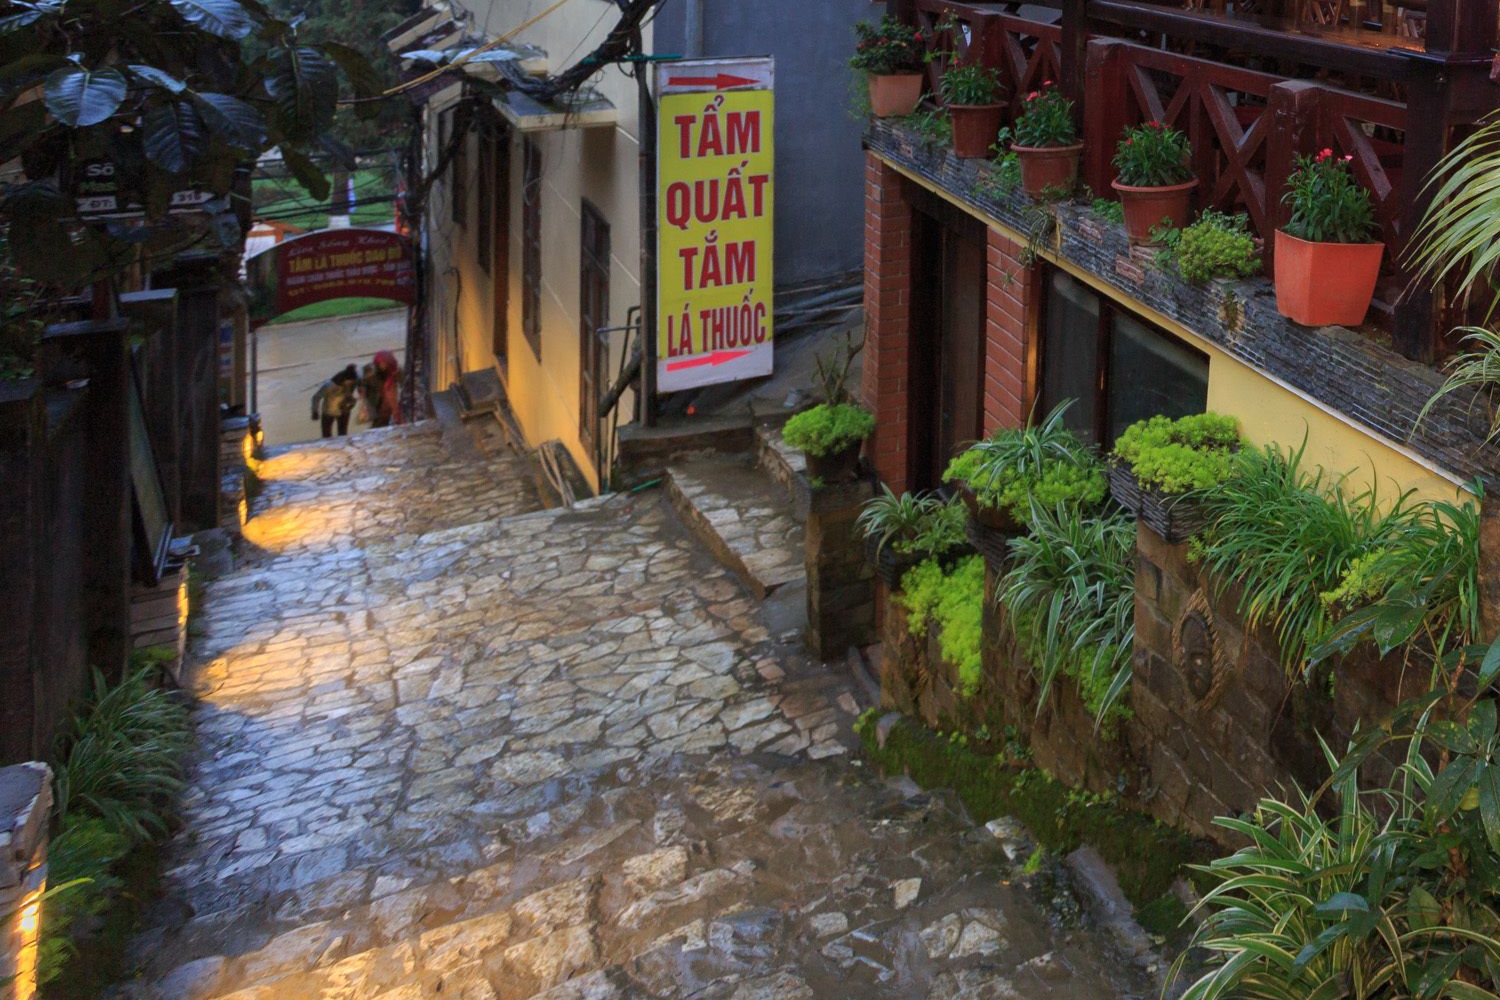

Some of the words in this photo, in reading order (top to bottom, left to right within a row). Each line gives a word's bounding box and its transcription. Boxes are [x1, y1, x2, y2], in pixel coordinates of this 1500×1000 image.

[674, 95, 761, 158] TẨM
[665, 160, 770, 230] QUẤT
[679, 229, 756, 290] TẮM
[667, 303, 693, 358] LÁ
[699, 288, 766, 353] THUỐC
